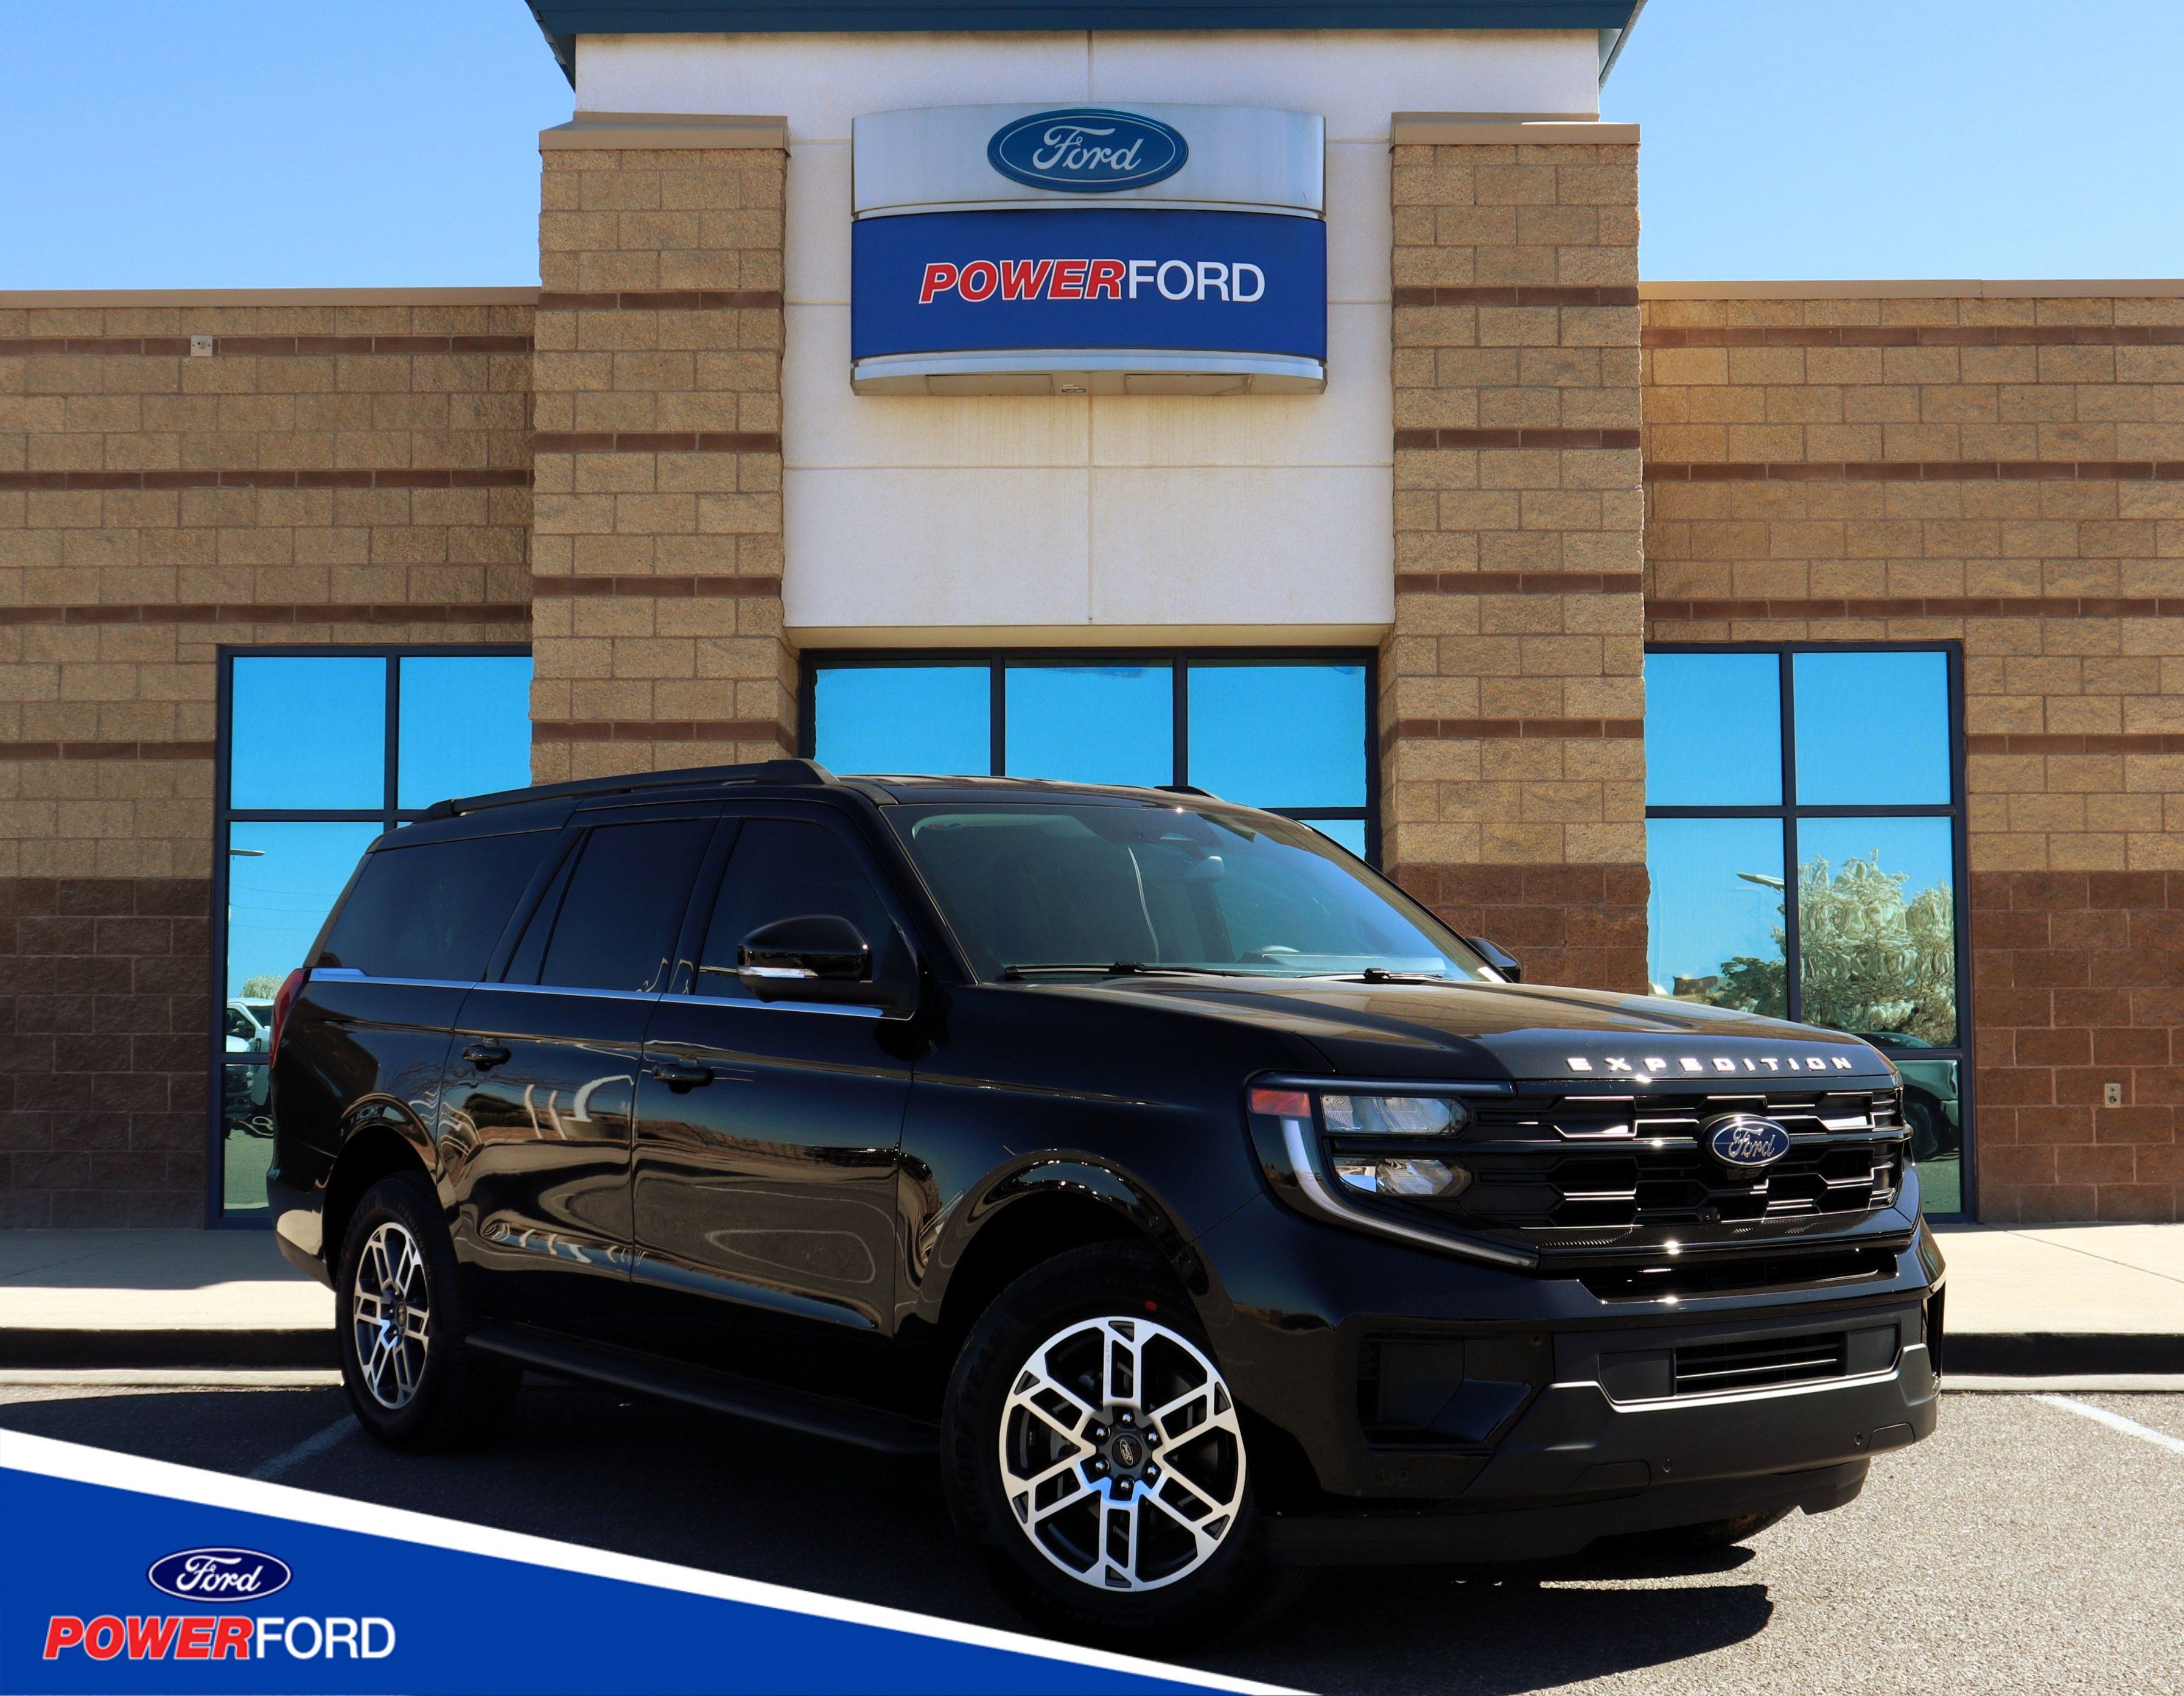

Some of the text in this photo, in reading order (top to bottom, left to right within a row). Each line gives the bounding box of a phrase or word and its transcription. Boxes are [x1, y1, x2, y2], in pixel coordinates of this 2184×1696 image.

[1033, 125, 1143, 170] Ford
[919, 259, 1265, 304] POWERFORD
[1567, 1057, 1852, 1072] EXPEDITION
[1728, 1127, 1776, 1158] Ford
